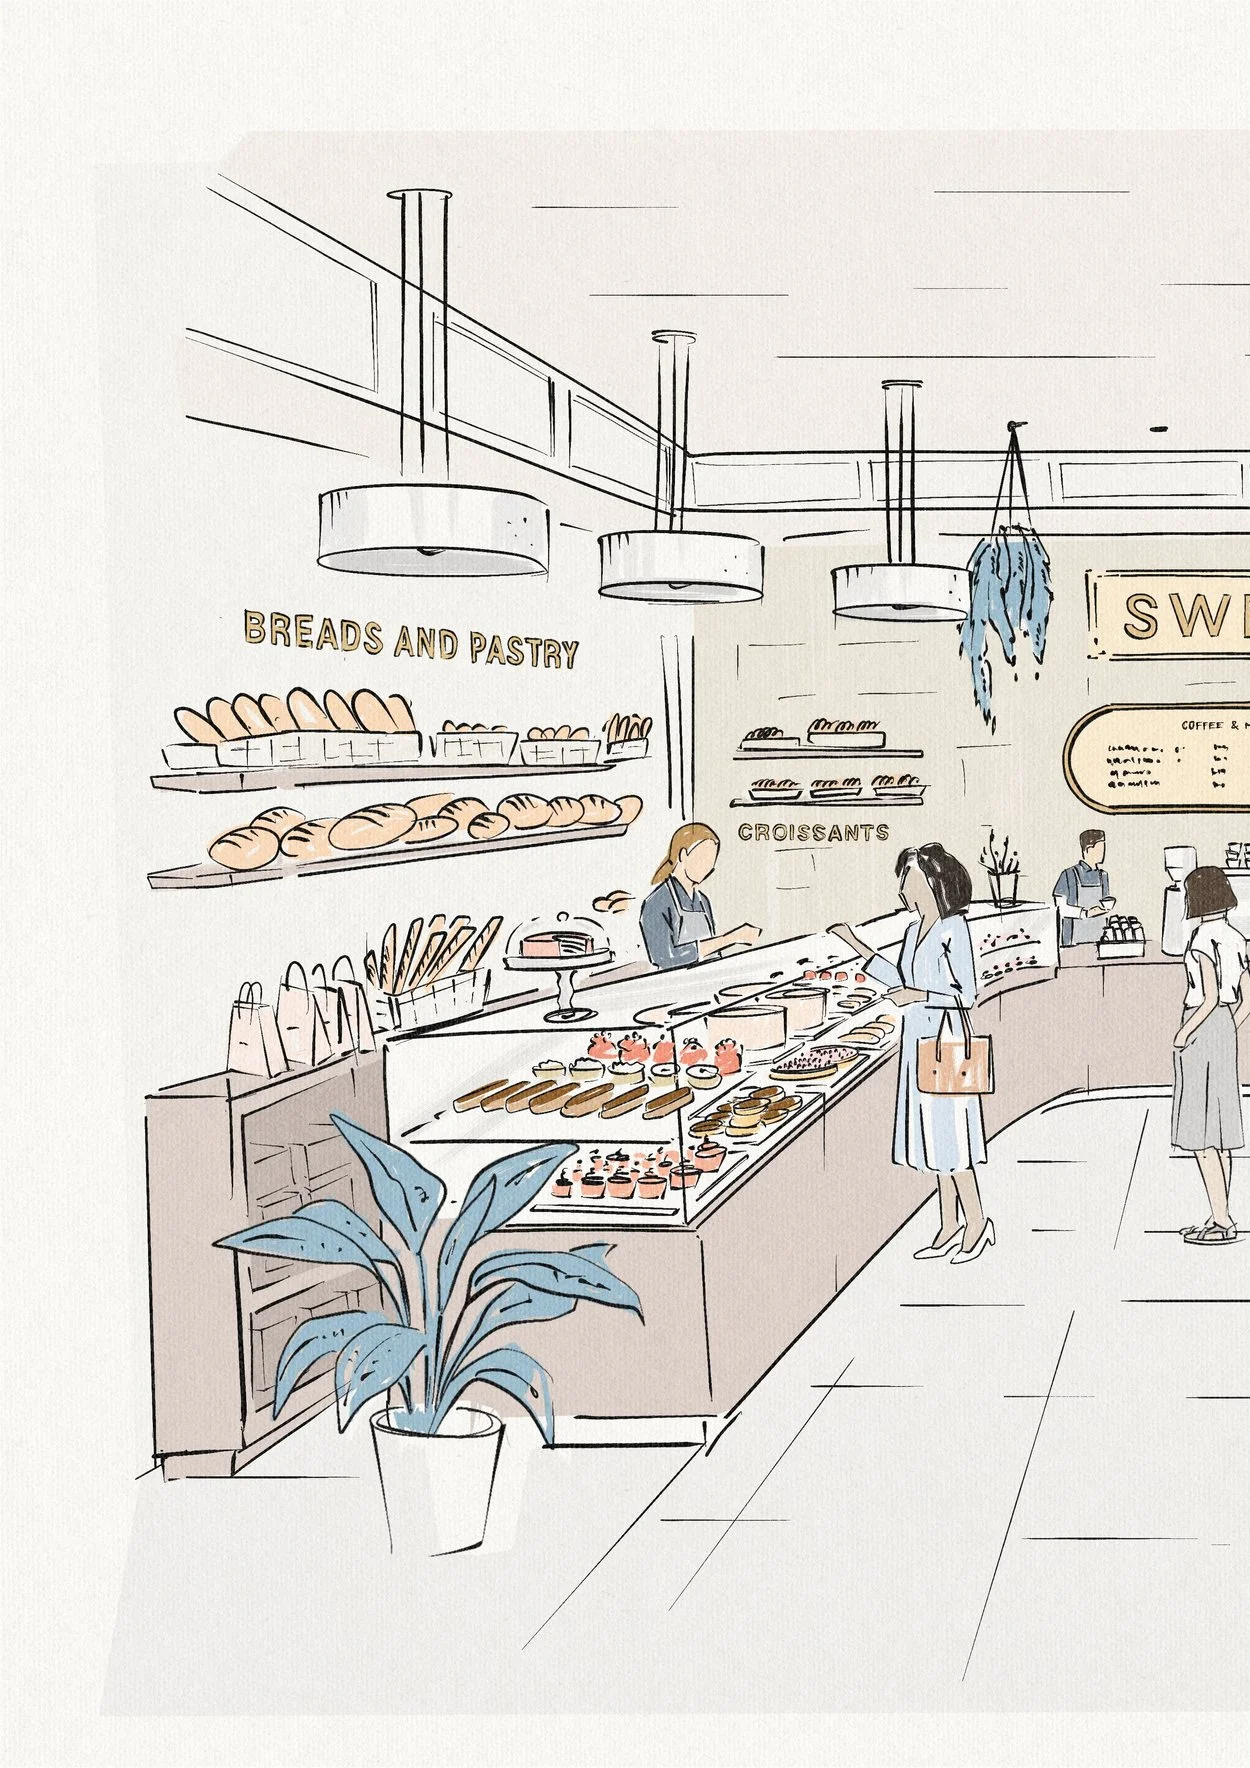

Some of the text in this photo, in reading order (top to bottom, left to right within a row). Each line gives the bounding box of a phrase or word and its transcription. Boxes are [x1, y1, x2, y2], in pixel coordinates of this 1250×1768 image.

[244, 609, 580, 669] BREADS AND PASTRY
[1181, 720, 1224, 731] COFFEE
[1231, 720, 1240, 731] &
[738, 822, 890, 842] CROISSANTS
